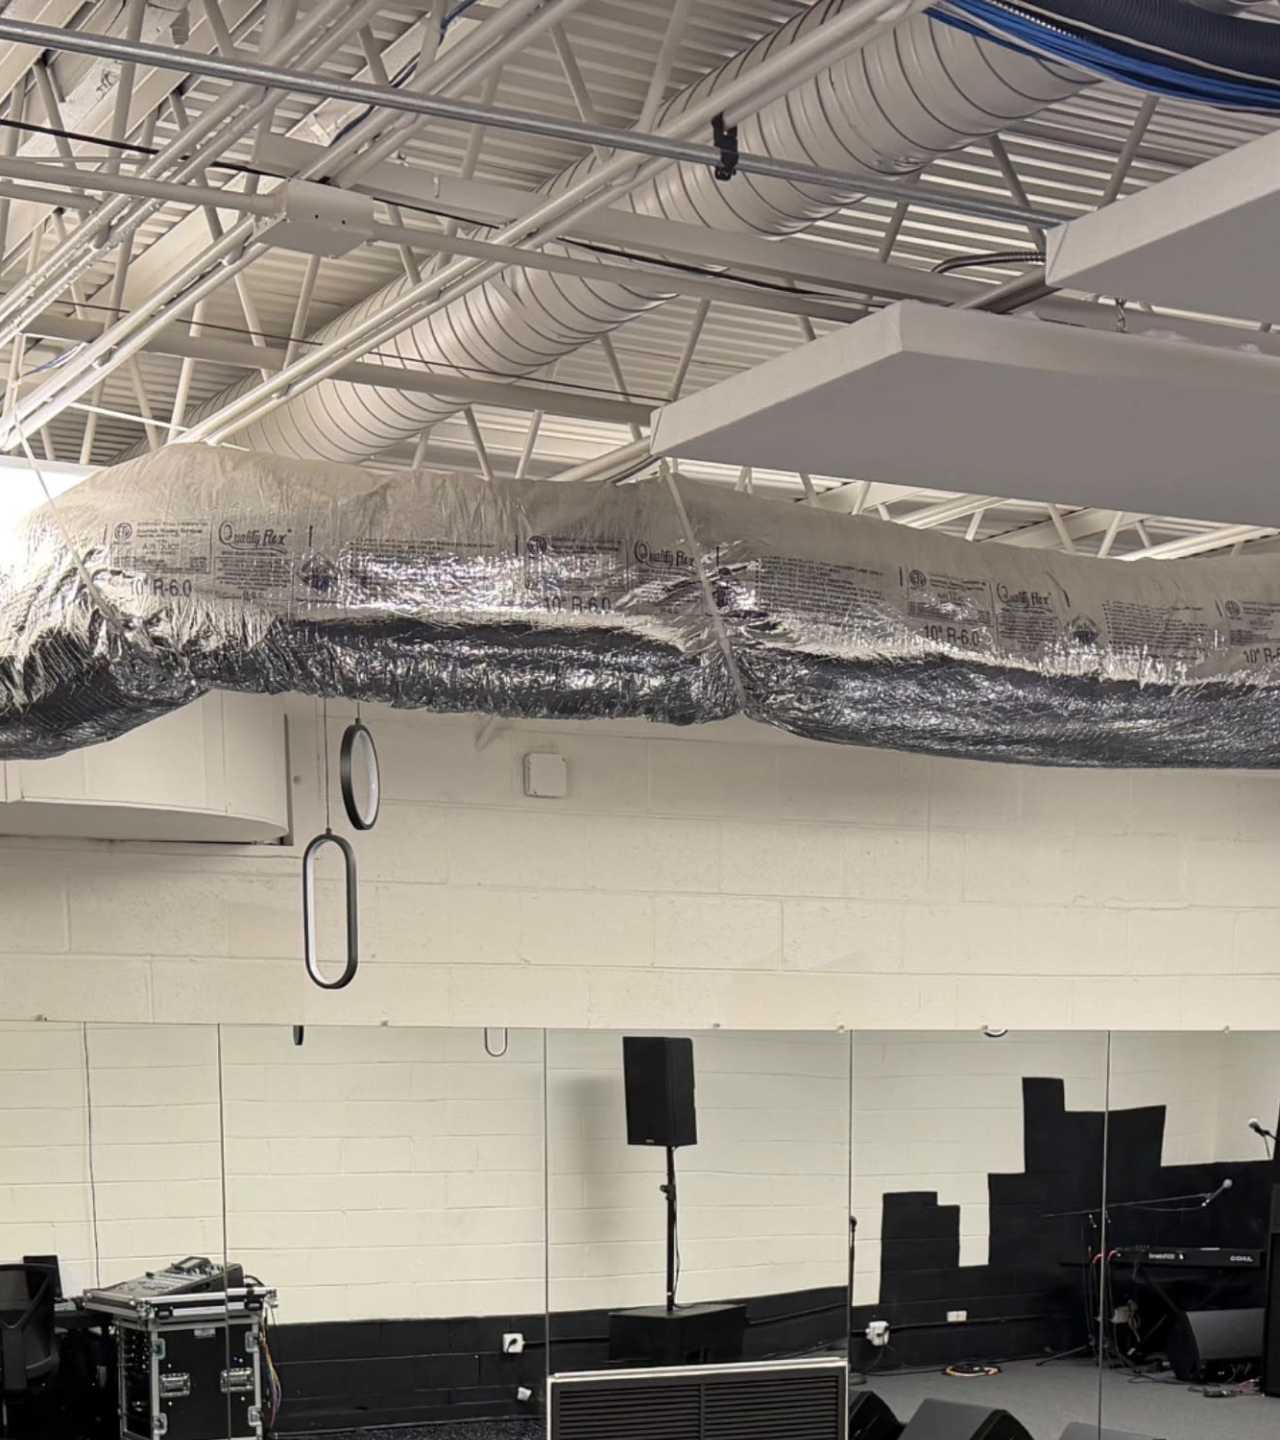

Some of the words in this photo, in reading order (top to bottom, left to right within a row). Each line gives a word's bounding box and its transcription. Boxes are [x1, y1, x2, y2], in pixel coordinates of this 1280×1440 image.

[219, 521, 261, 549] Quality
[262, 528, 287, 547] Flex
[153, 577, 192, 598] R-6.0
[946, 626, 981, 647] R-6.0
